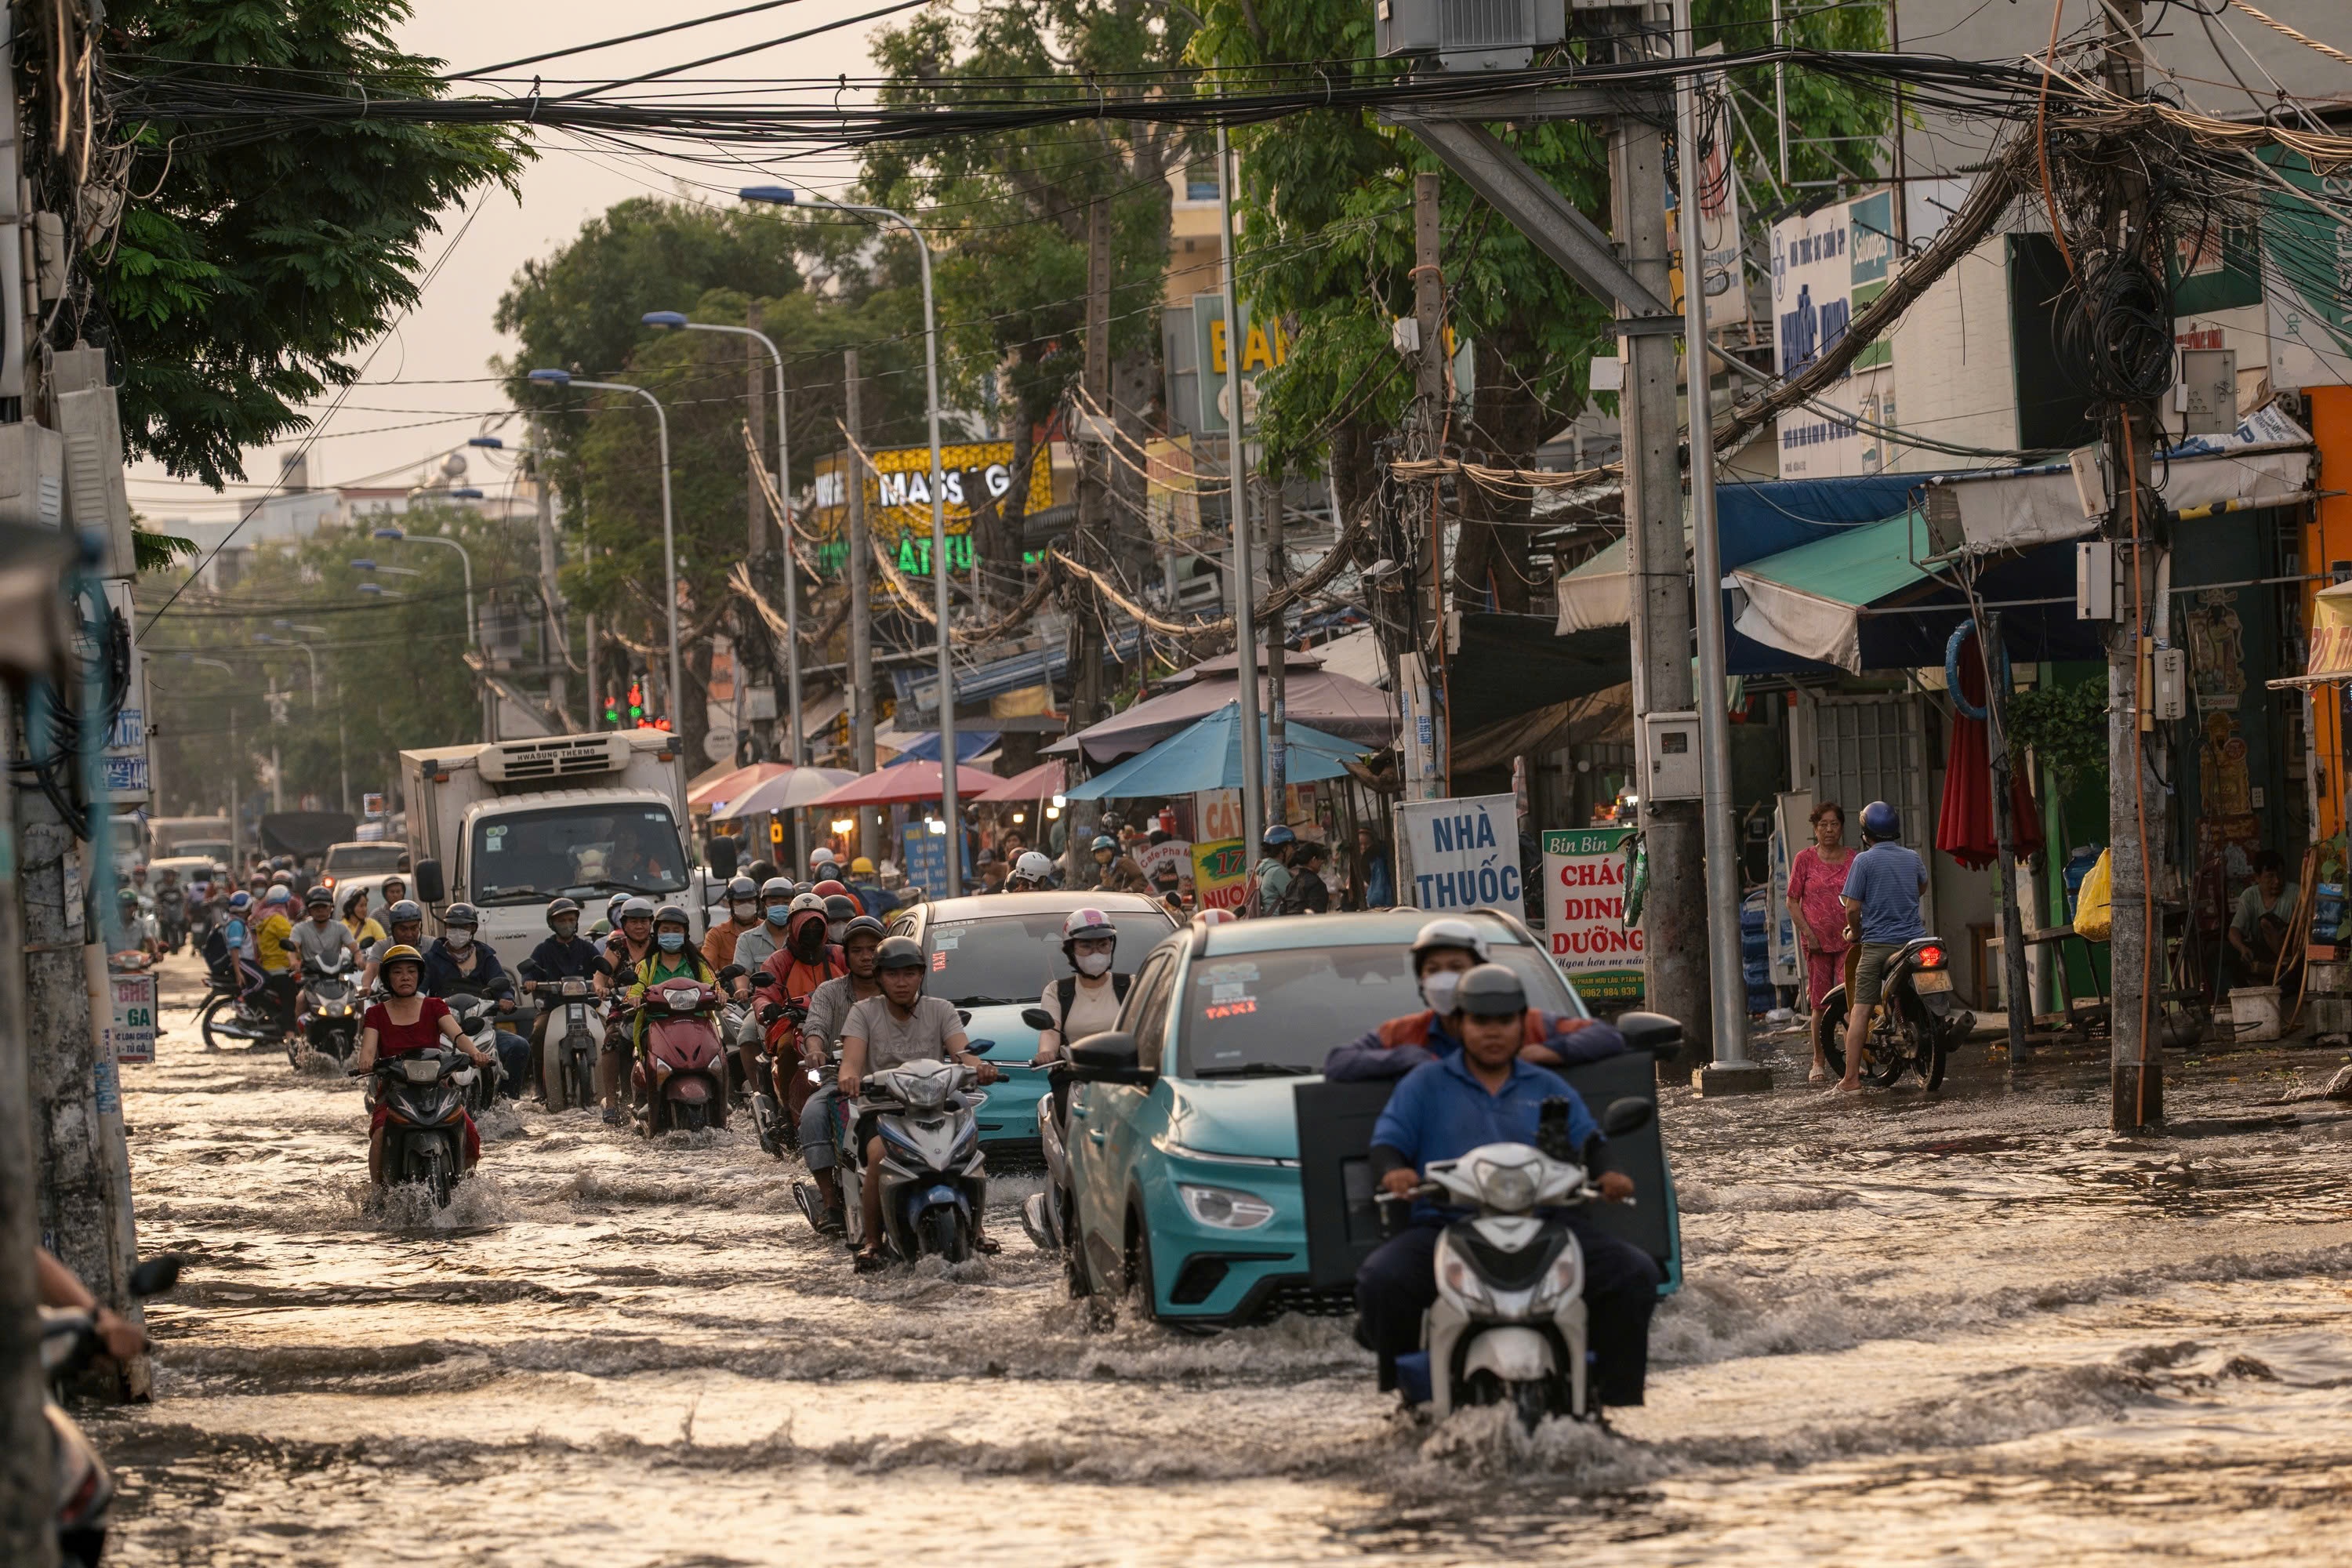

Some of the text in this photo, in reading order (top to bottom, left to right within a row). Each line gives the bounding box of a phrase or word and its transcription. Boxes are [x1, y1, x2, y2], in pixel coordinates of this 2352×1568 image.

[1854, 229, 1888, 267] Salonpas
[880, 464, 1013, 507] MASSG
[2208, 696, 2235, 706] Castrol
[517, 748, 595, 761] HWASUNG THERMO
[1432, 804, 1497, 853] NHÀ
[1550, 837, 1608, 854] Bin Bin
[1416, 854, 1520, 909] THUỐC
[1552, 925, 1643, 955] DƯỠNG
[931, 951, 946, 973] TAXI
[1555, 957, 1584, 970] Ngon
[1587, 956, 1606, 967] hơn
[1609, 960, 1623, 969] mẹ
[1581, 986, 1637, 998] 0962 984 939
[127, 1008, 151, 1027] GA
[1206, 1000, 1258, 1019] TAXI
